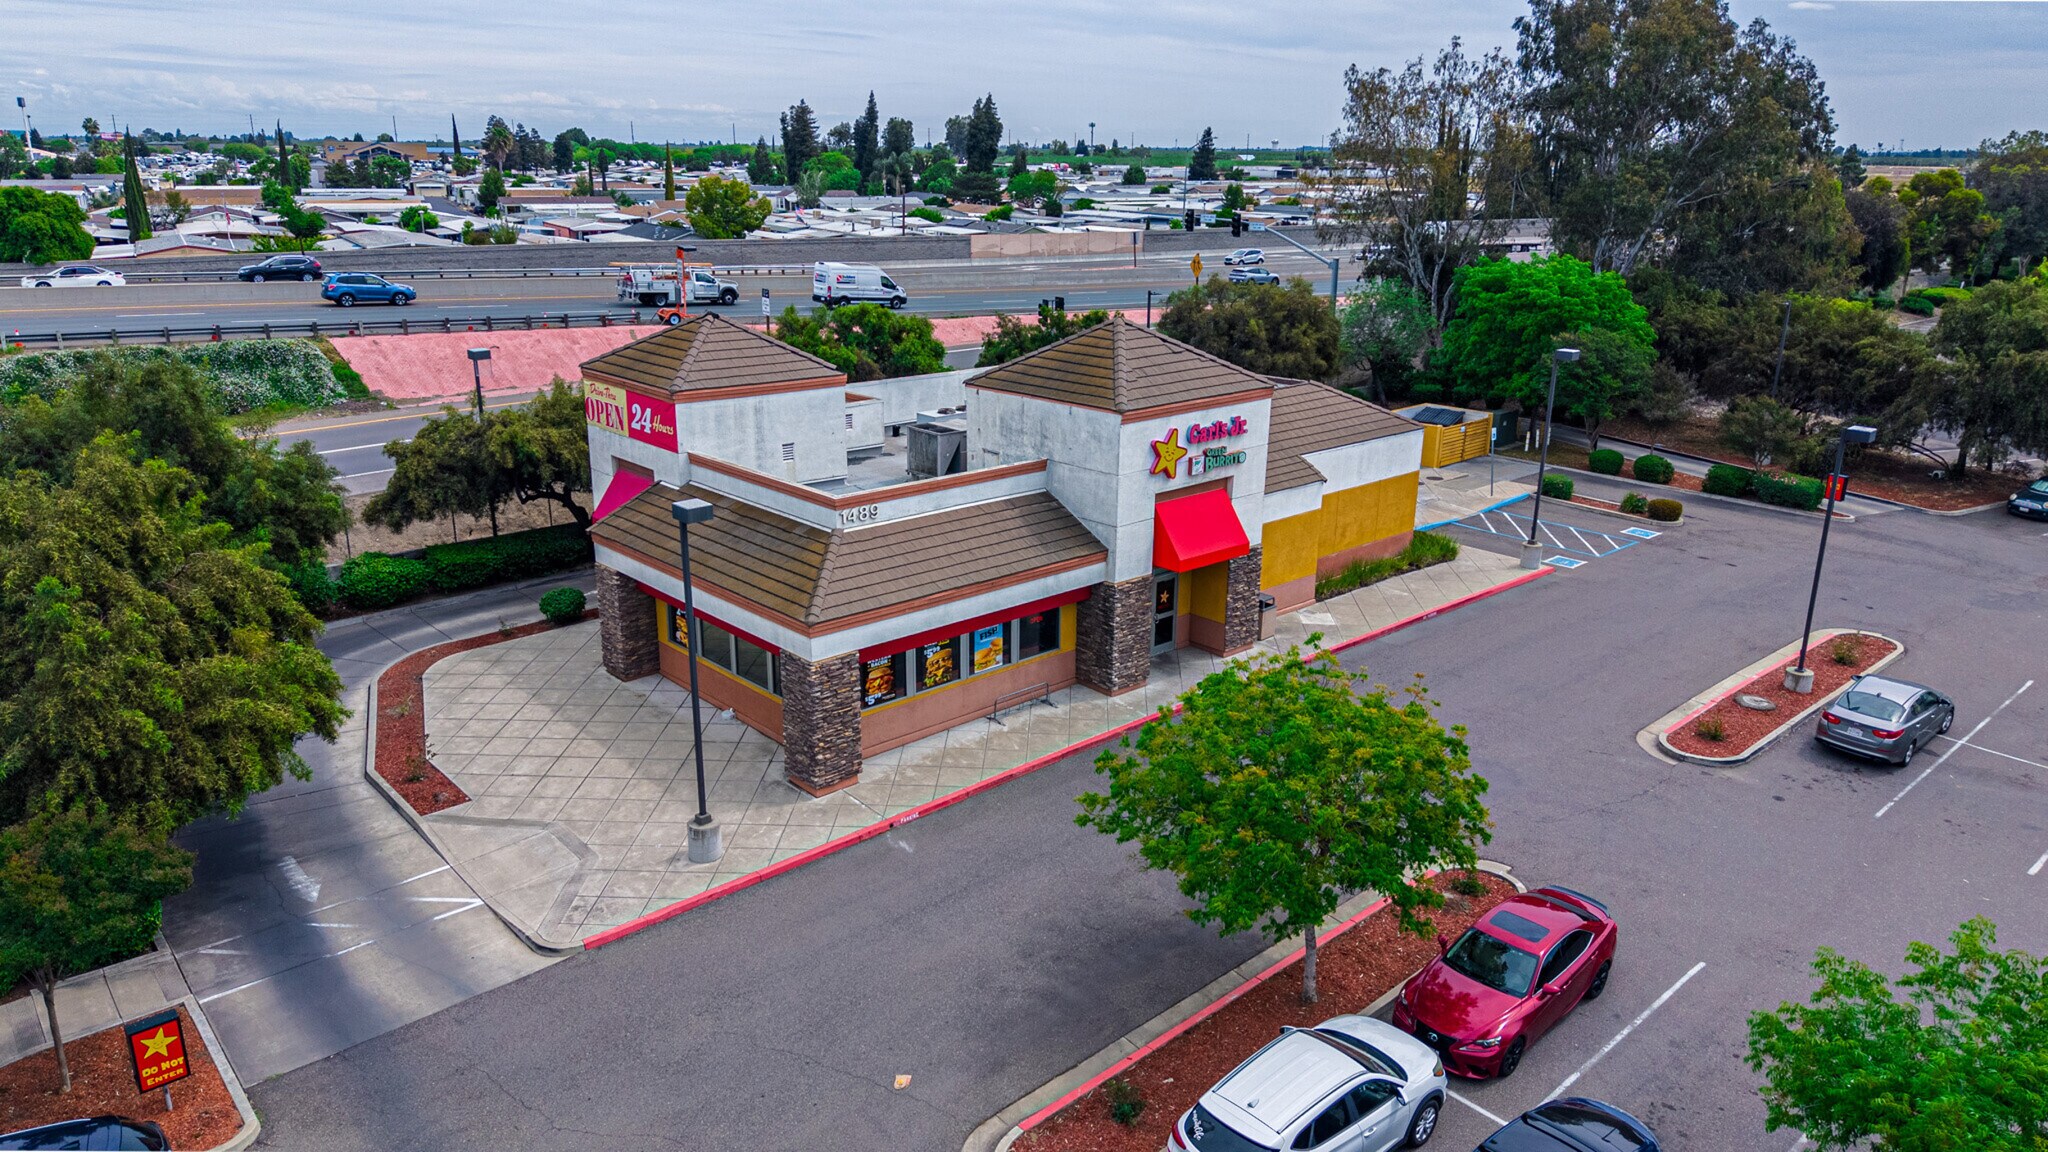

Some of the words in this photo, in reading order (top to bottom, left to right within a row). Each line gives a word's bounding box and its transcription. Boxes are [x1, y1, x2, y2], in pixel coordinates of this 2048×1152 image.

[585, 396, 624, 432] OPEN
[631, 403, 652, 434] 24
[652, 414, 674, 435] Hours
[1187, 420, 1228, 445] Carl's
[1229, 416, 1248, 437] Jr.
[1207, 446, 1227, 456] GREEN
[1205, 452, 1246, 472] BURRITO
[839, 503, 879, 525] 1489
[979, 626, 998, 640] FISH
[142, 1066, 159, 1077] DO
[161, 1056, 184, 1070] NOT
[146, 1068, 184, 1086] ENTER
